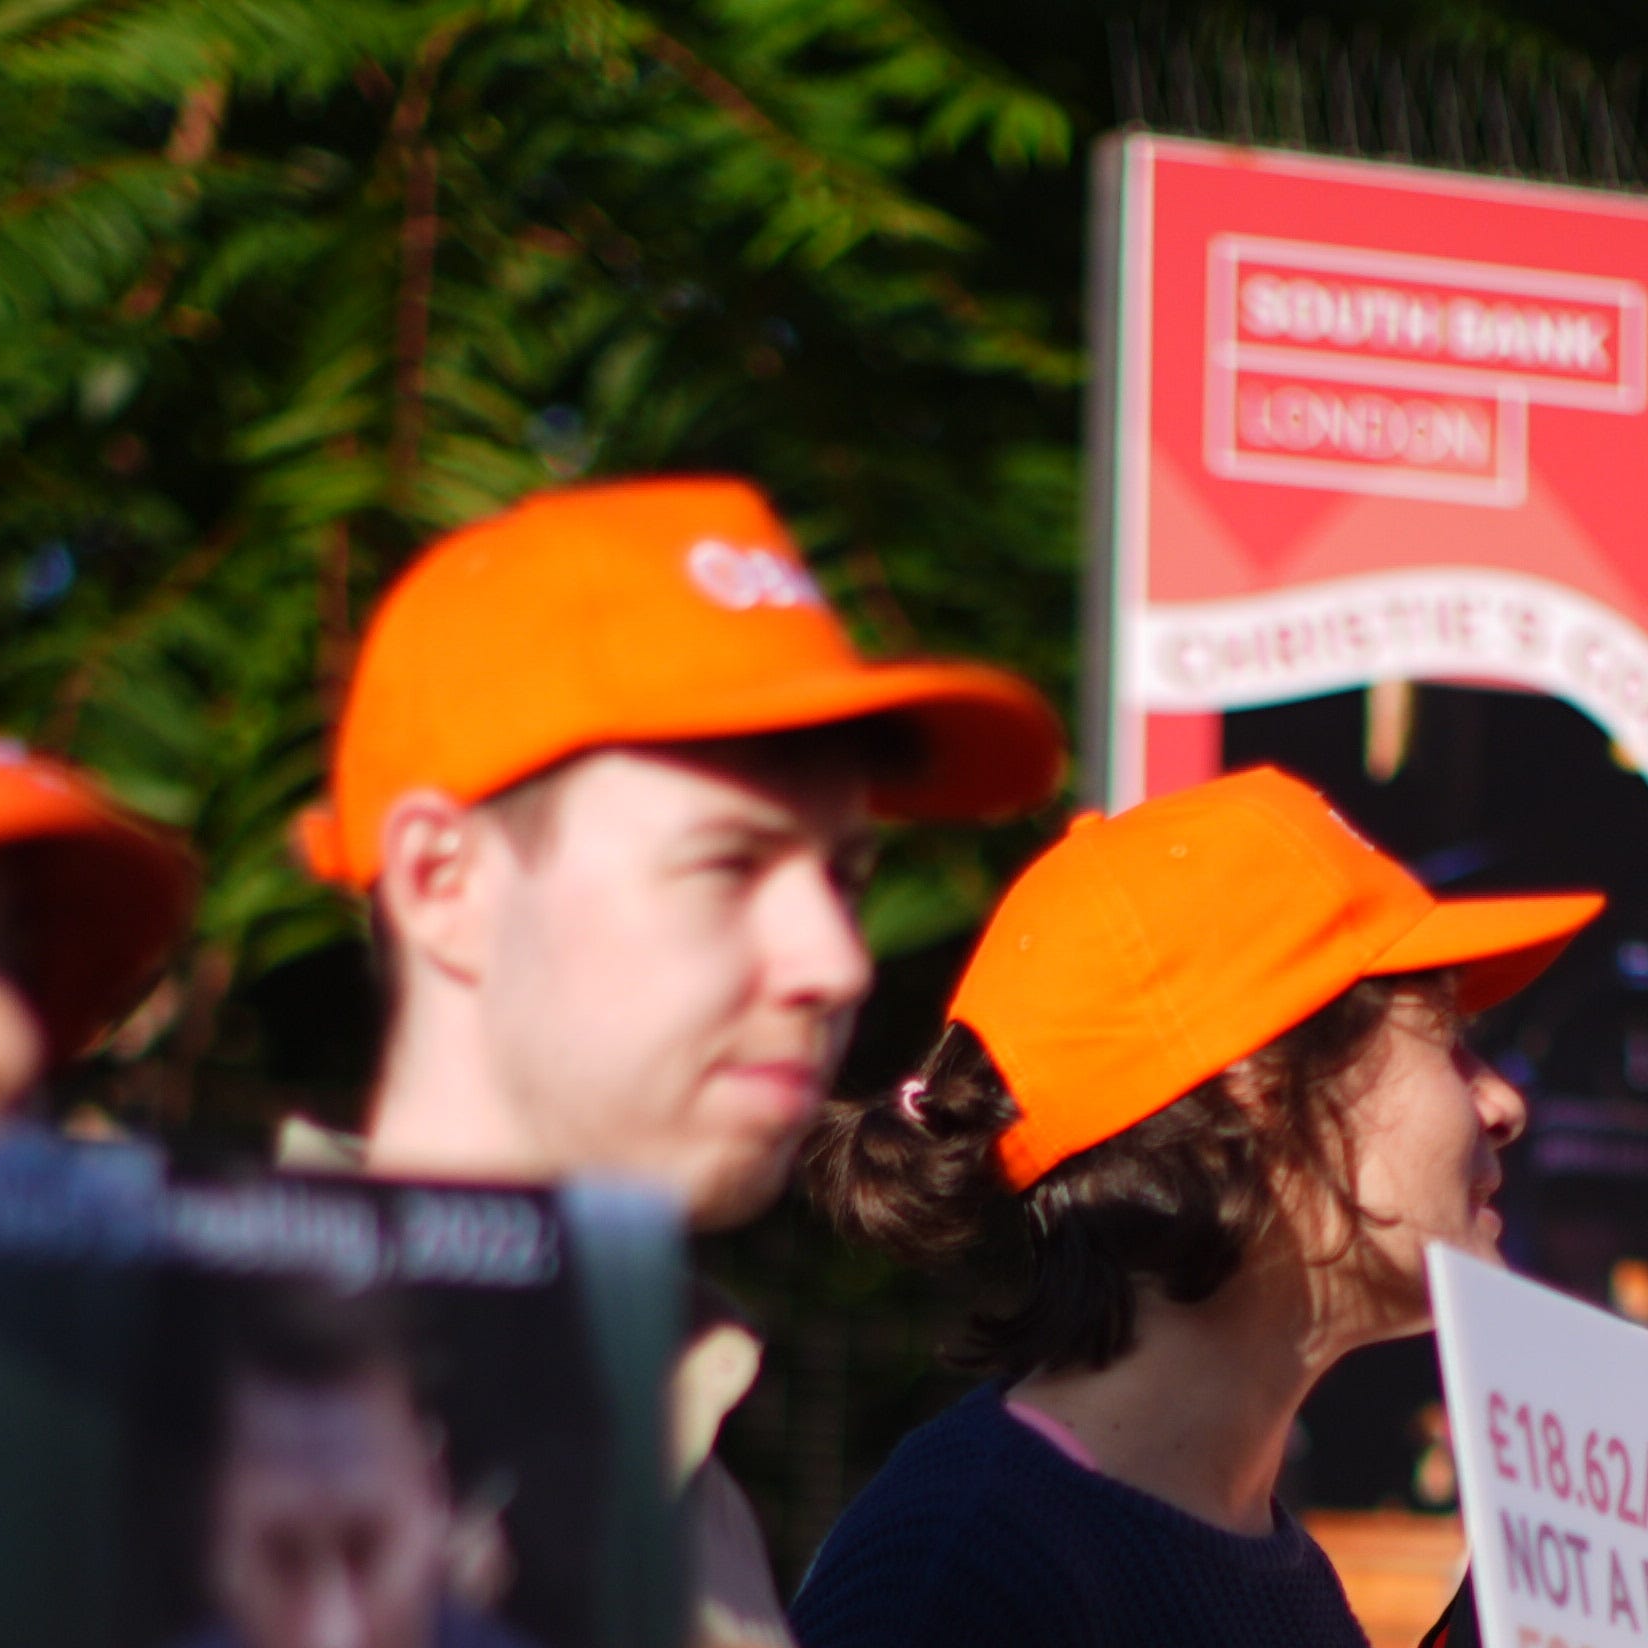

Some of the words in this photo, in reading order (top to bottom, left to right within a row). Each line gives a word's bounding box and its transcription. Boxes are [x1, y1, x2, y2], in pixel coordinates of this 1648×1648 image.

[1448, 294, 1611, 374] BANK
[1499, 1510, 1593, 1611] NOT
[1607, 1548, 1642, 1635] A
